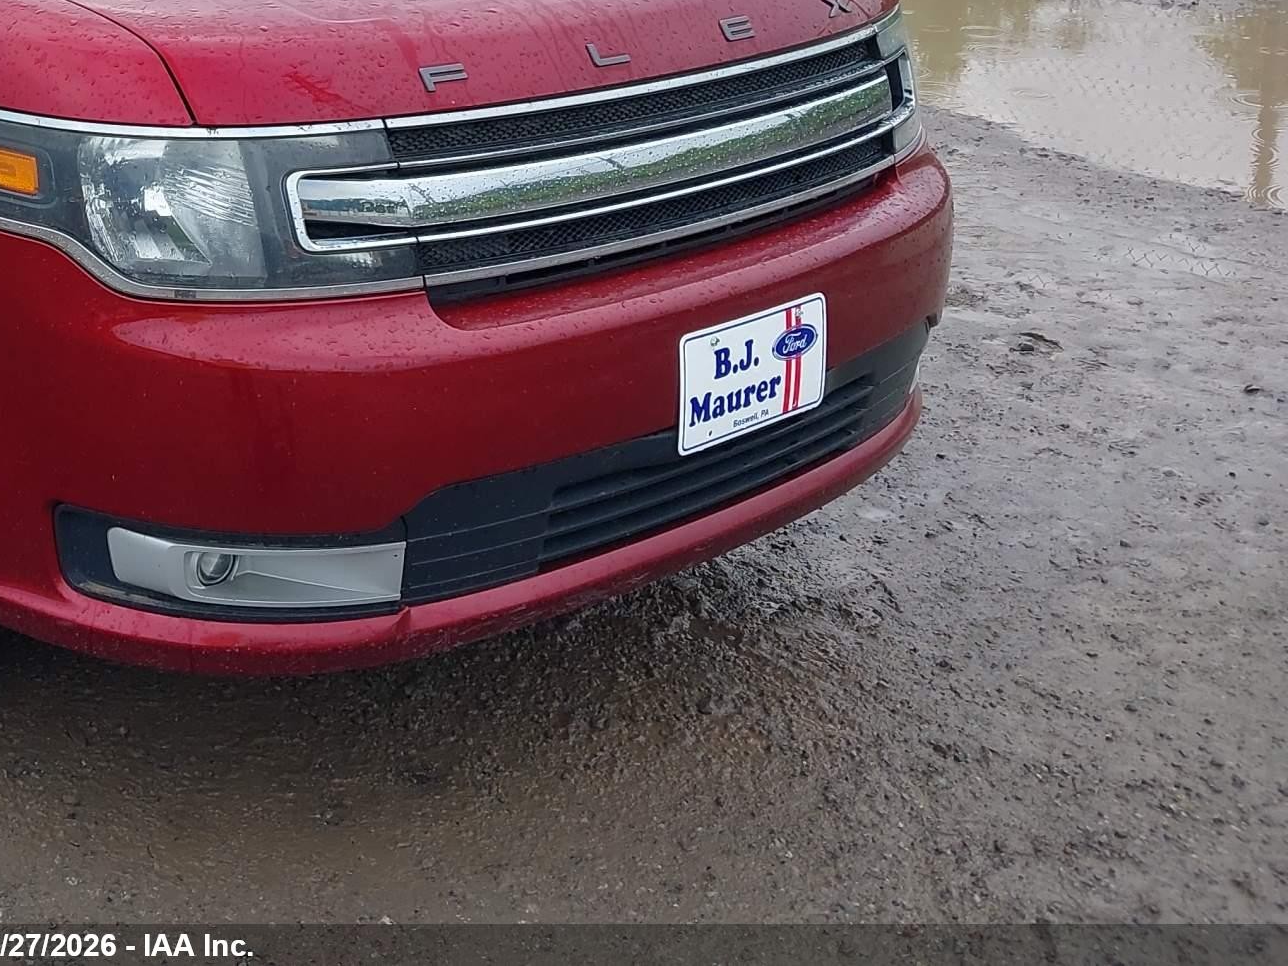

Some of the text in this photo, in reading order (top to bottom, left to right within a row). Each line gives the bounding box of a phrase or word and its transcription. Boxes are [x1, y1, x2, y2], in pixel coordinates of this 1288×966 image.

[714, 339, 759, 379] B.J.
[782, 331, 808, 354] Ford
[689, 375, 782, 427] Maurer
